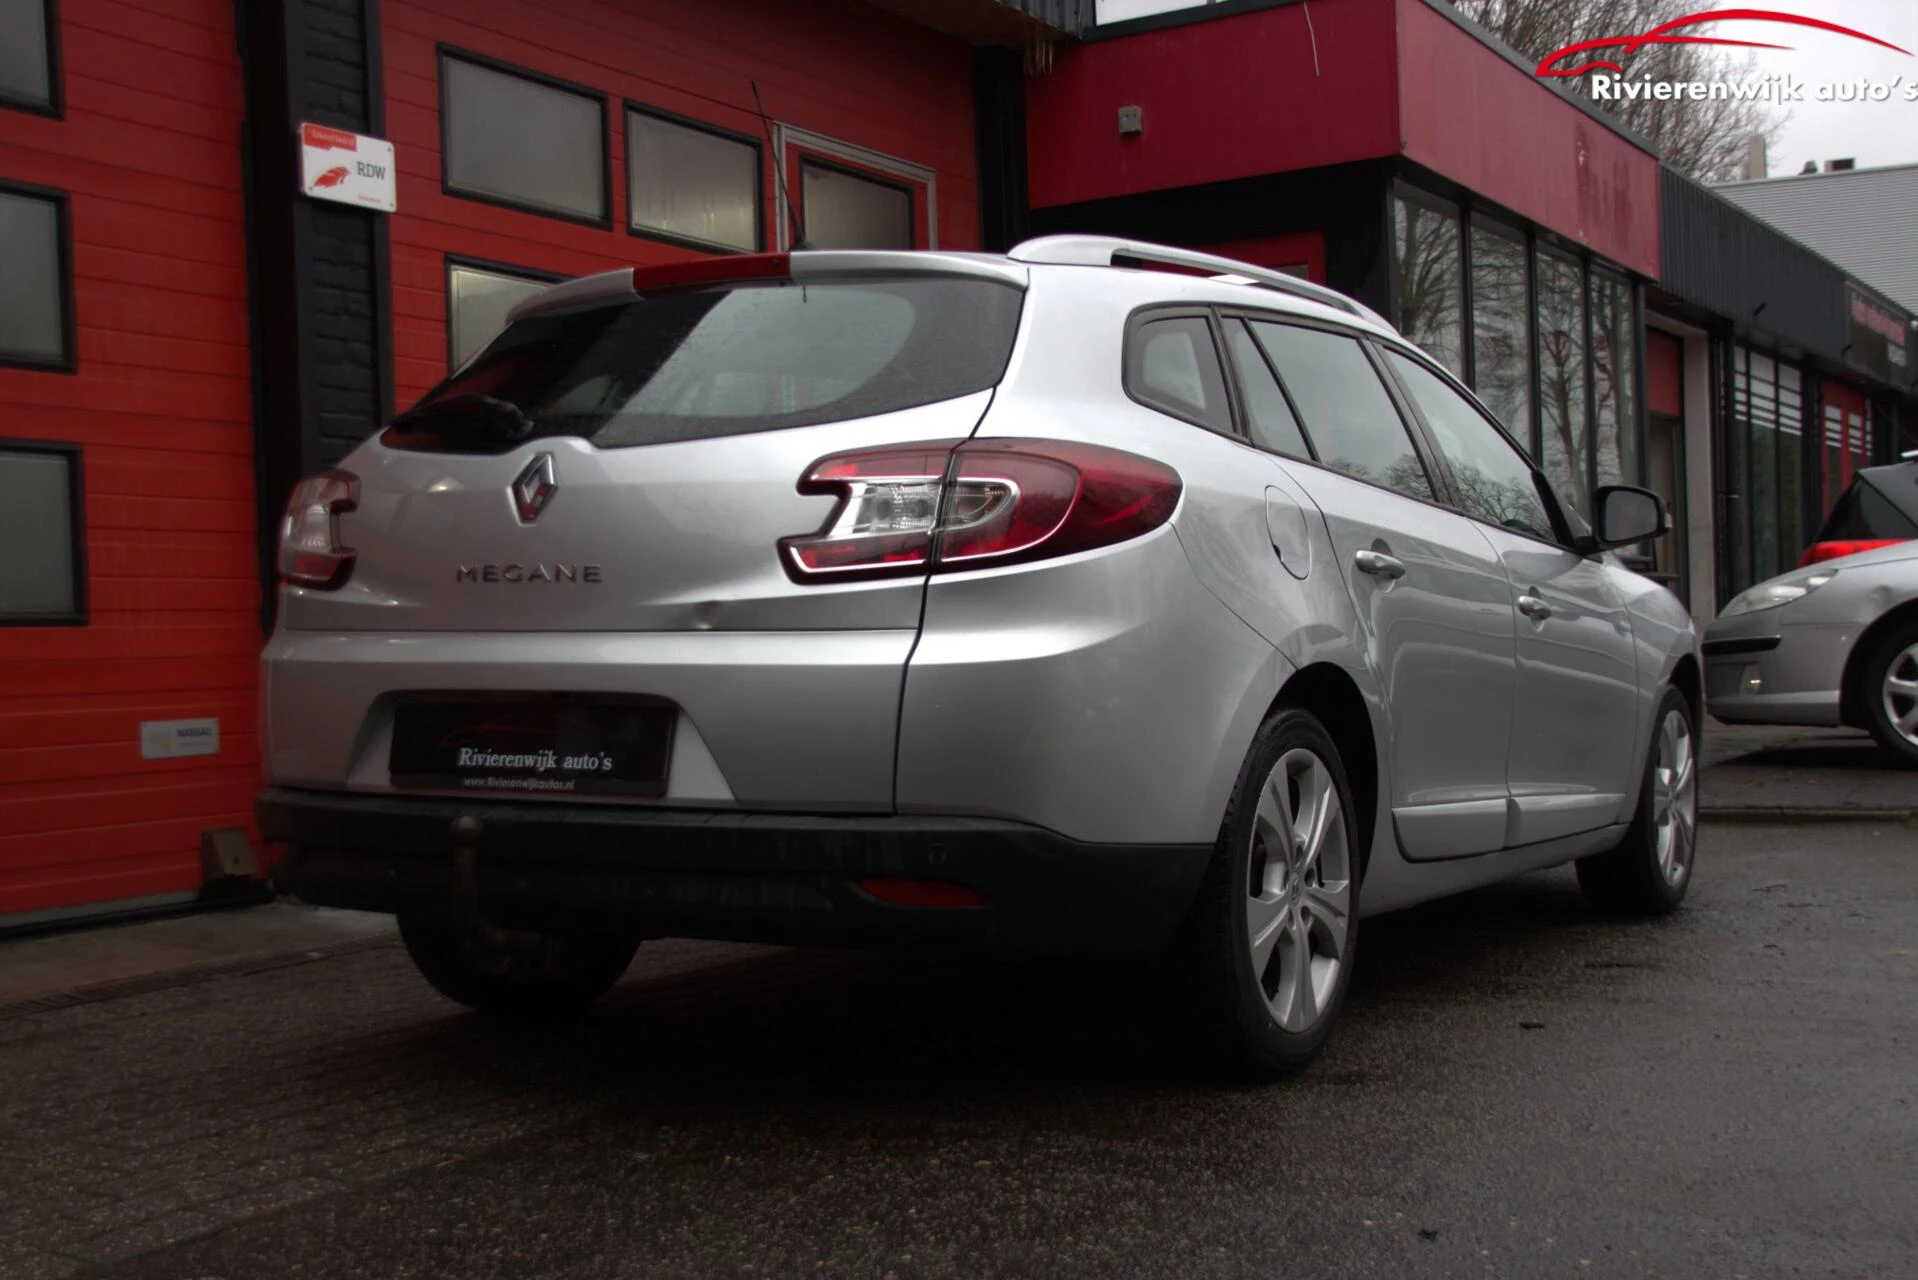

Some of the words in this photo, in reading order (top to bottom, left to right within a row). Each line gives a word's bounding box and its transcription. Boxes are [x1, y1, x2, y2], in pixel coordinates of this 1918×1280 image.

[356, 161, 386, 180] RDW
[455, 563, 603, 584] MEGANE
[458, 747, 557, 771] Rivierenwijk
[563, 752, 613, 770] auto's
